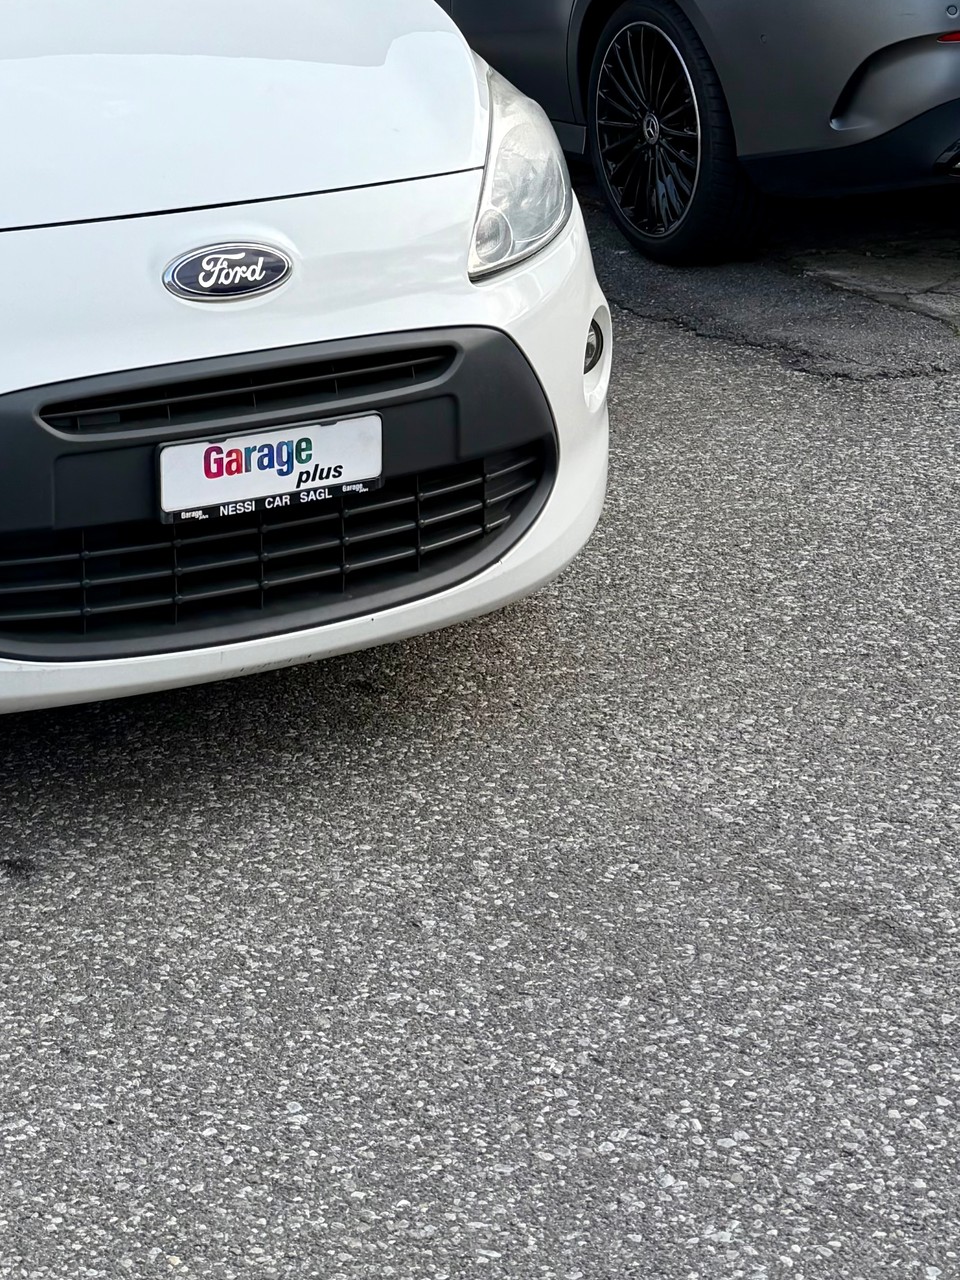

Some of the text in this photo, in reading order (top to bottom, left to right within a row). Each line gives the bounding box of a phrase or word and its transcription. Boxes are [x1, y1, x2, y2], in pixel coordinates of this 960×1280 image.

[198, 252, 266, 288] Ford
[203, 437, 313, 480] Garage
[296, 464, 344, 488] plus
[342, 483, 363, 493] Garage
[181, 509, 203, 519] Garage
[219, 488, 333, 517] NESSI CAR SAGL
